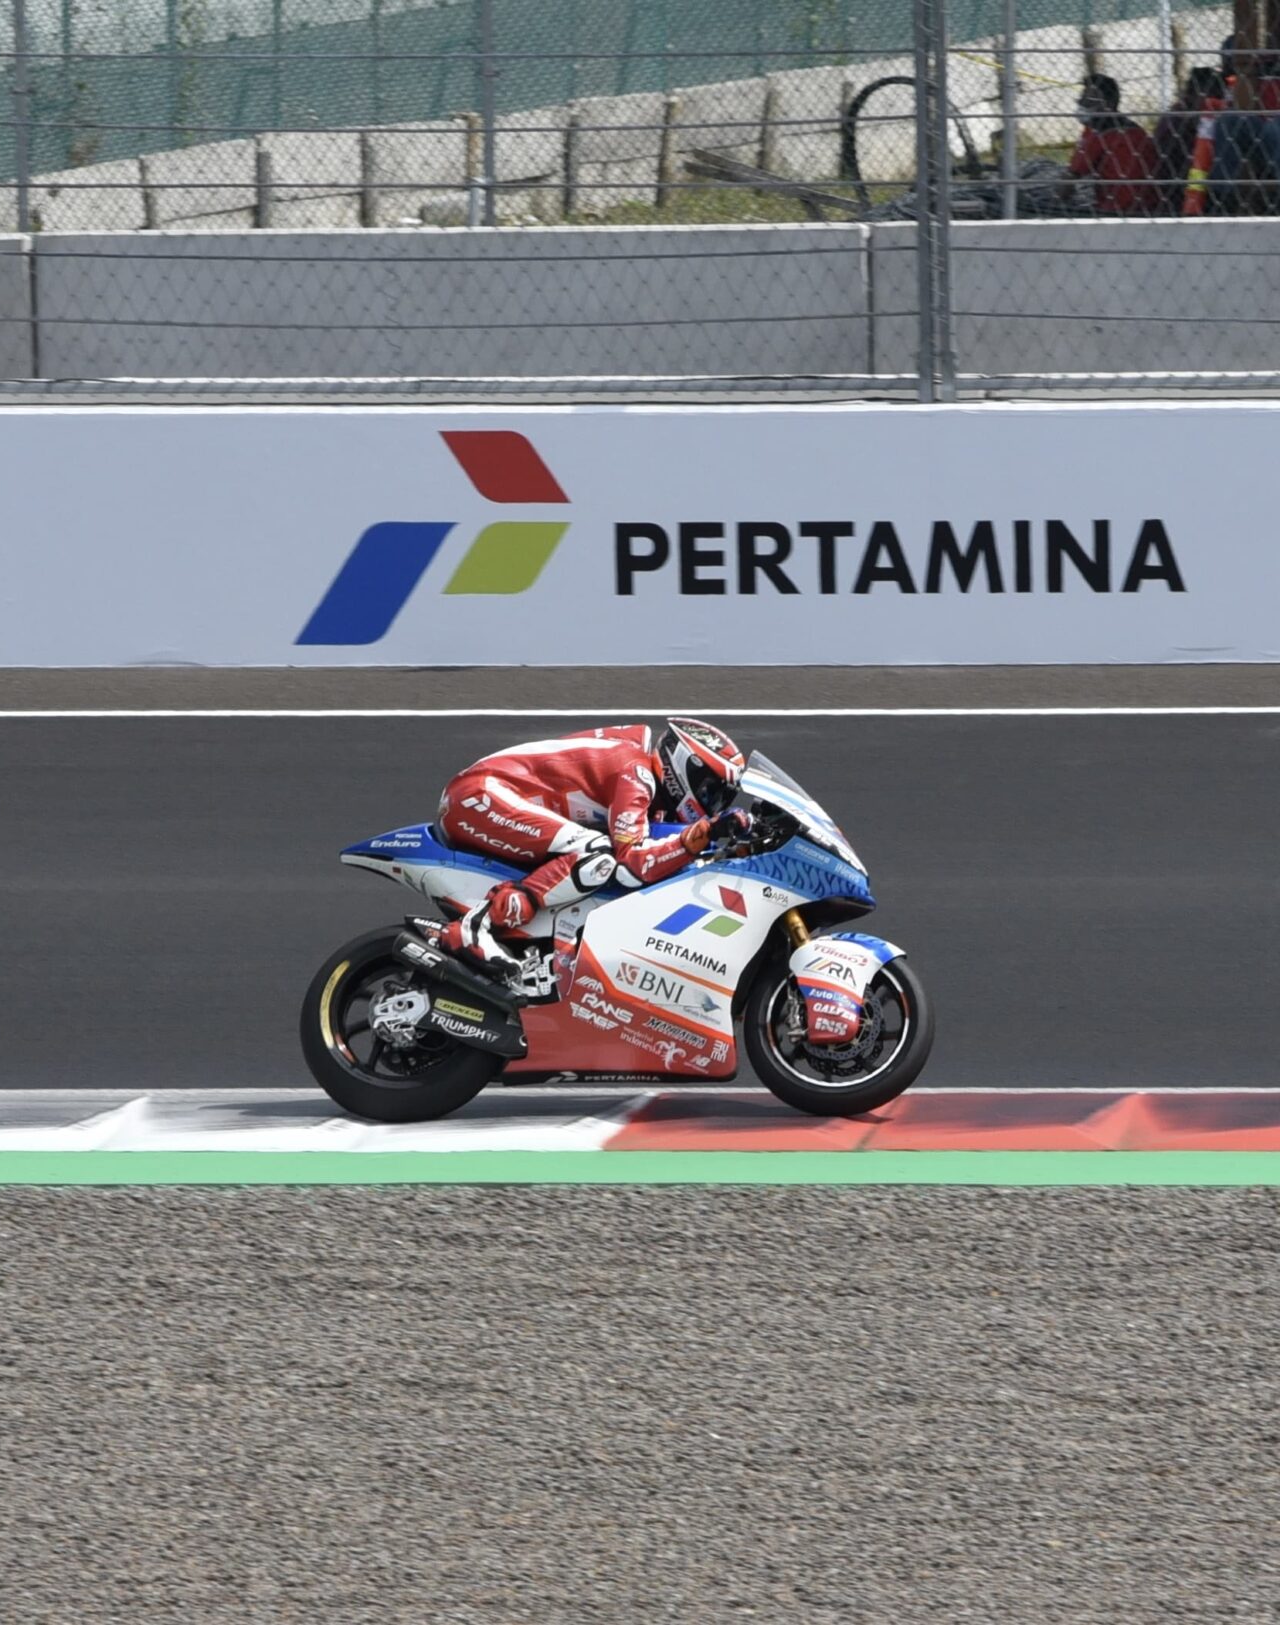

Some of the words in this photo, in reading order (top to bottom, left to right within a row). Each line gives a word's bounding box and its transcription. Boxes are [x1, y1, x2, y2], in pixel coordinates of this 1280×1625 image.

[616, 519, 1185, 595] PERTAMINA
[487, 811, 542, 838] PERTAMINA
[370, 840, 421, 848] Enduro
[645, 937, 727, 976] PERTAMINA
[638, 970, 686, 1004] BNI
[581, 993, 634, 1024] RANS
[430, 1012, 487, 1040] TRIUMPH
[585, 1074, 661, 1082] PERTAMINA
